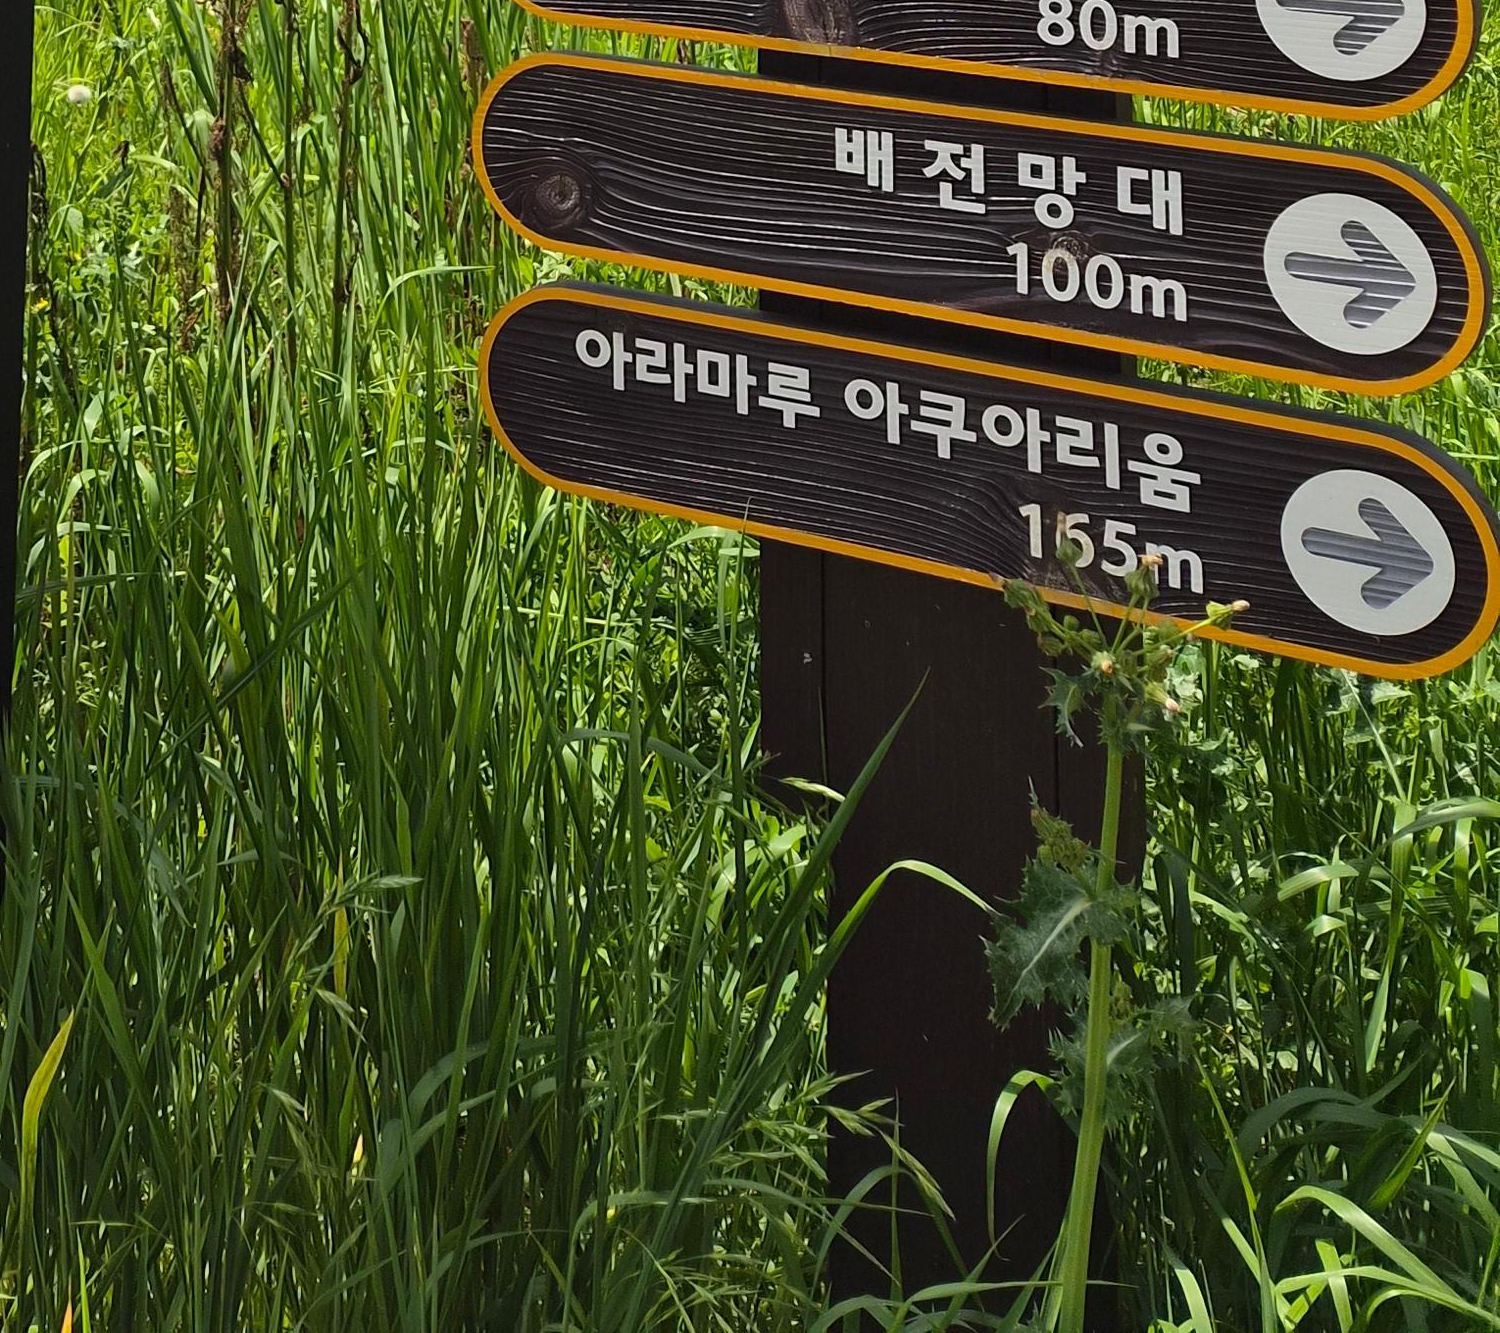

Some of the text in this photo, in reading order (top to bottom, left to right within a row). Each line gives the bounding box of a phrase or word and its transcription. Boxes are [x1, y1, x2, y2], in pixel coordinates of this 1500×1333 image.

[1007, 241, 1188, 322] 100m
[575, 328, 1201, 513] 아라마루 아쿠아리움
